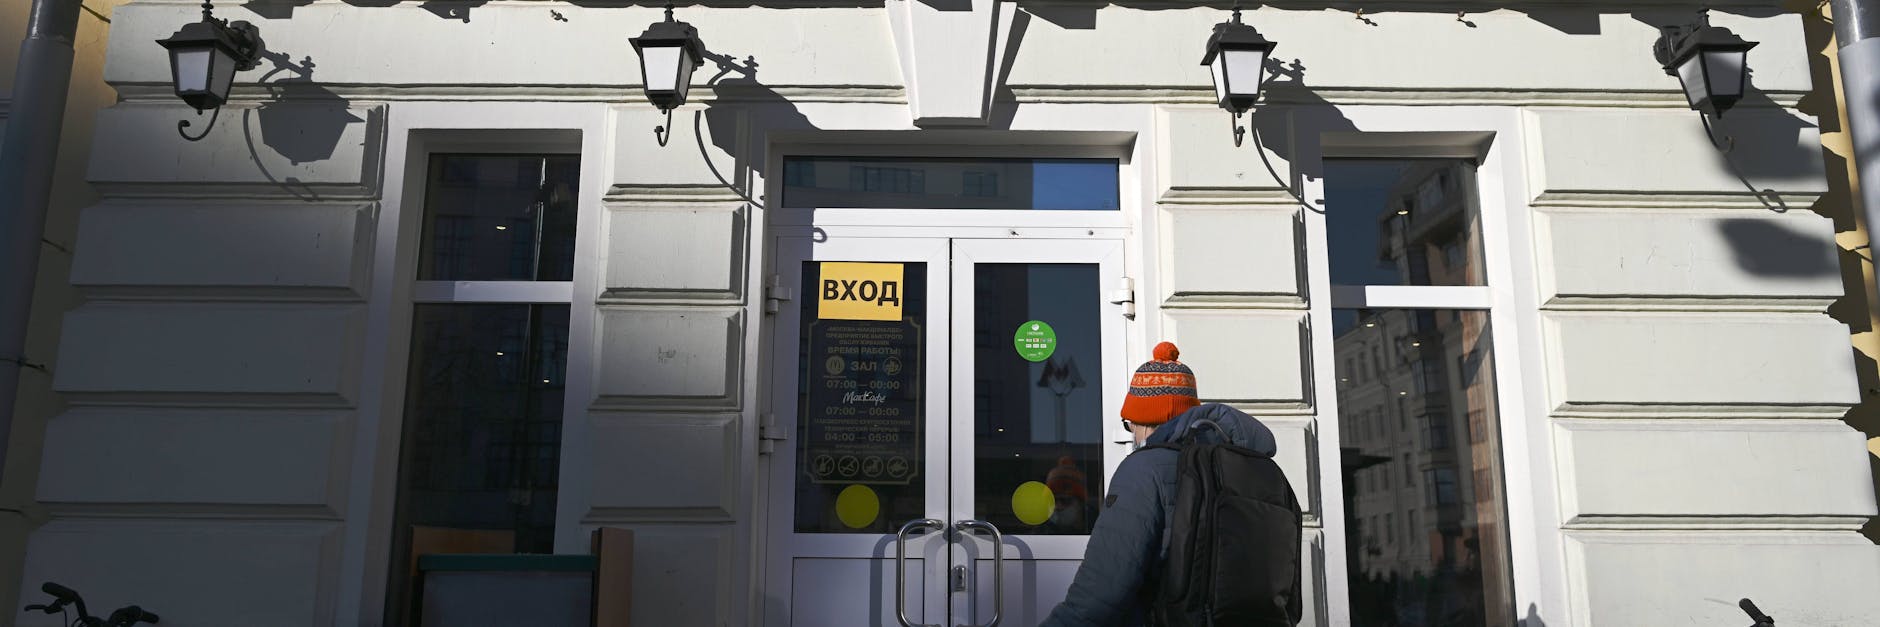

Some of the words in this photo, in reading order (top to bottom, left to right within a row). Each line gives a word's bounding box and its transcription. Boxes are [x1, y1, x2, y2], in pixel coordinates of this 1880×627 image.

[823, 279, 899, 307] ВХОД
[828, 346, 859, 354] ВРЕМЯ
[850, 361, 877, 371] ЗАЛ
[826, 380, 856, 389] 07:00
[869, 380, 900, 389] 00:00
[826, 407, 855, 416] 07:00
[869, 407, 899, 416] 00:00
[825, 432, 855, 441] 04:00
[868, 433, 899, 442] 05:00
